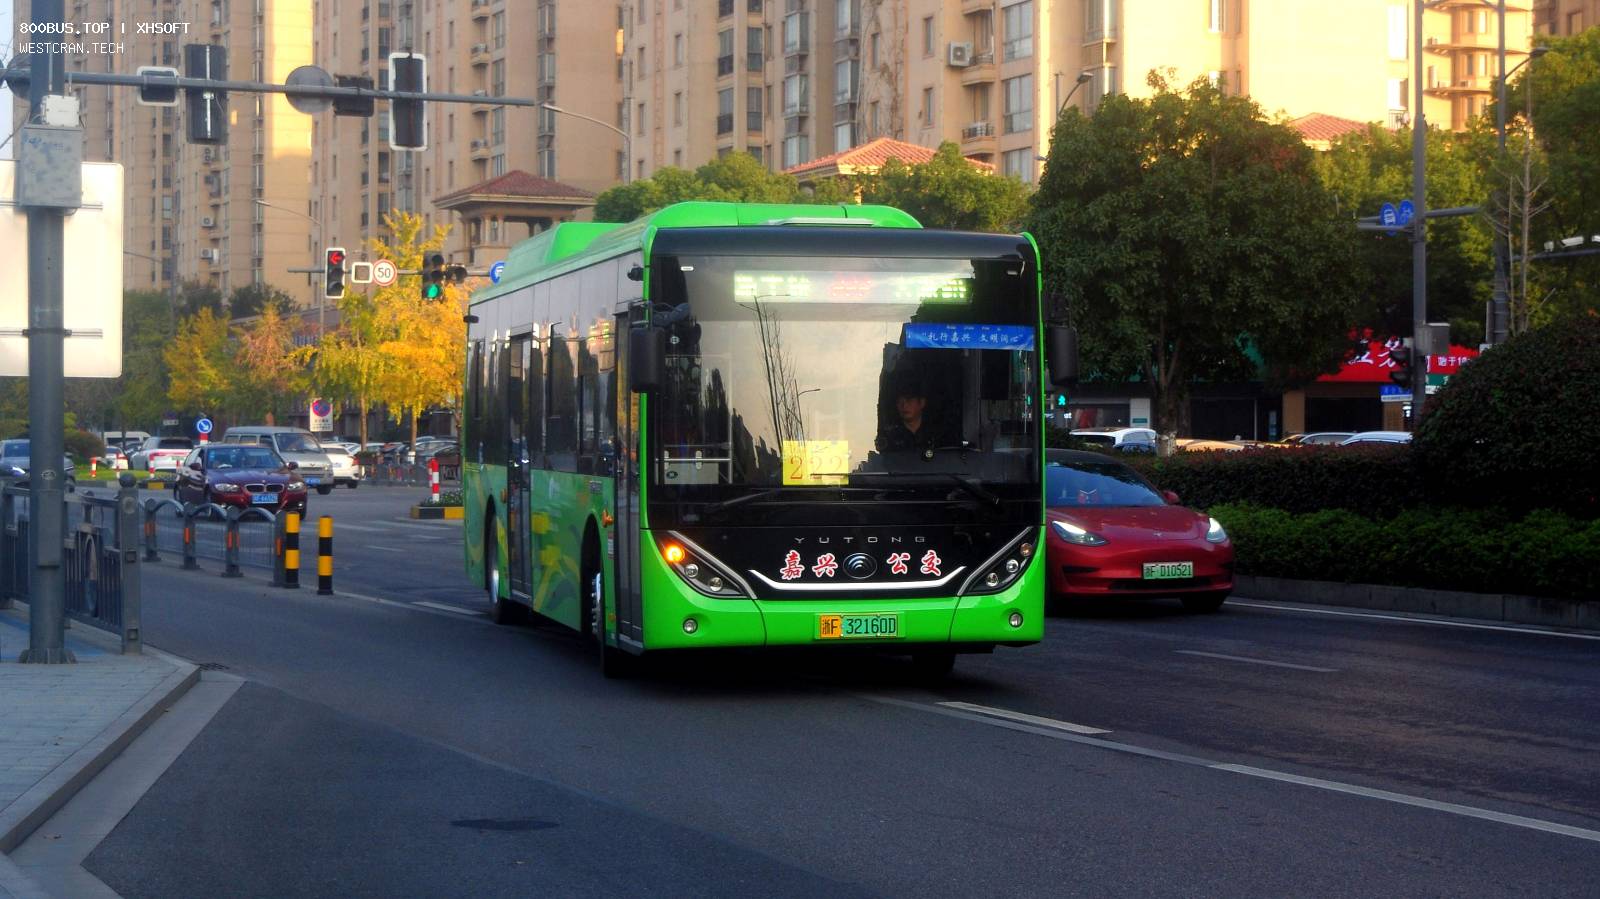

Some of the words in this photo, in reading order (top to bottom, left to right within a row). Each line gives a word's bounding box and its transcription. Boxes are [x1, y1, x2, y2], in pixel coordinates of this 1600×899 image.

[377, 267, 391, 279] 50
[794, 536, 925, 544] YUTONG
[780, 550, 839, 580] 嘉兴
[886, 550, 942, 577] 公交
